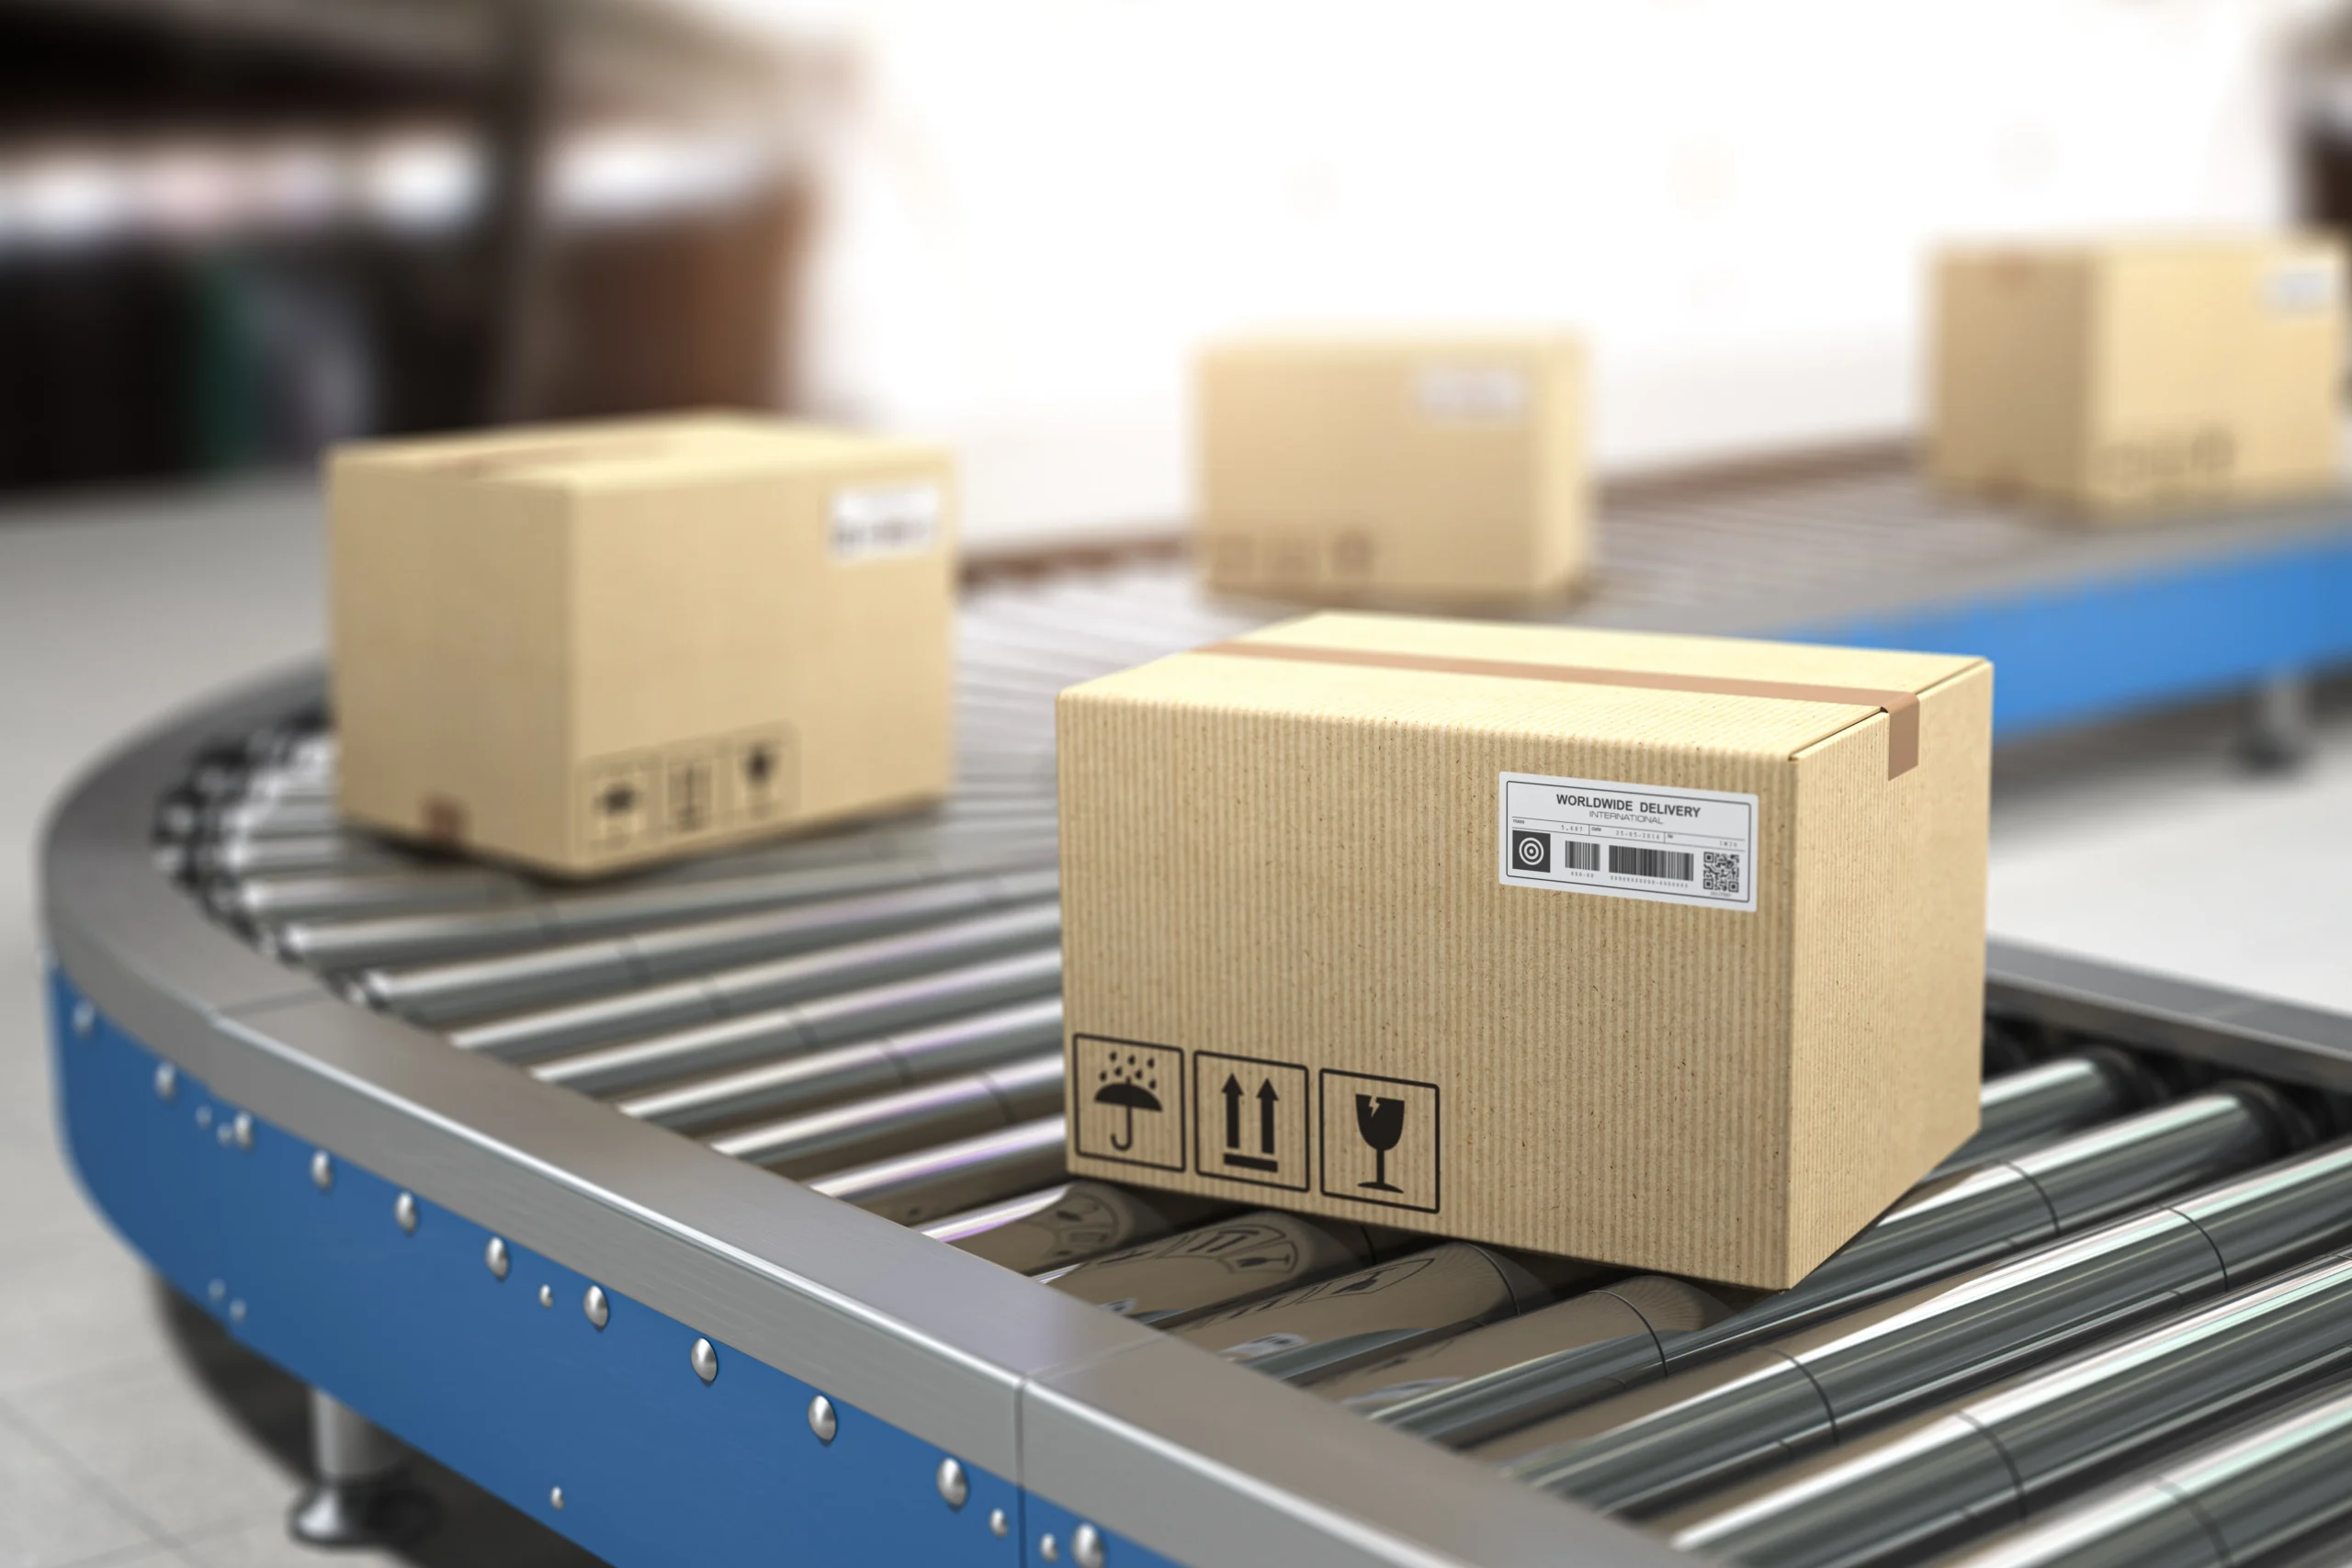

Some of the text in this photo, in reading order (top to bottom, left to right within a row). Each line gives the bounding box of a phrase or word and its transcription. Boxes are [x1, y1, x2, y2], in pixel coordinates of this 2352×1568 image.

[1556, 794, 1701, 818] WORLDWIDE DELIVERY
[1589, 810, 1664, 825] INTERNATIONAL
